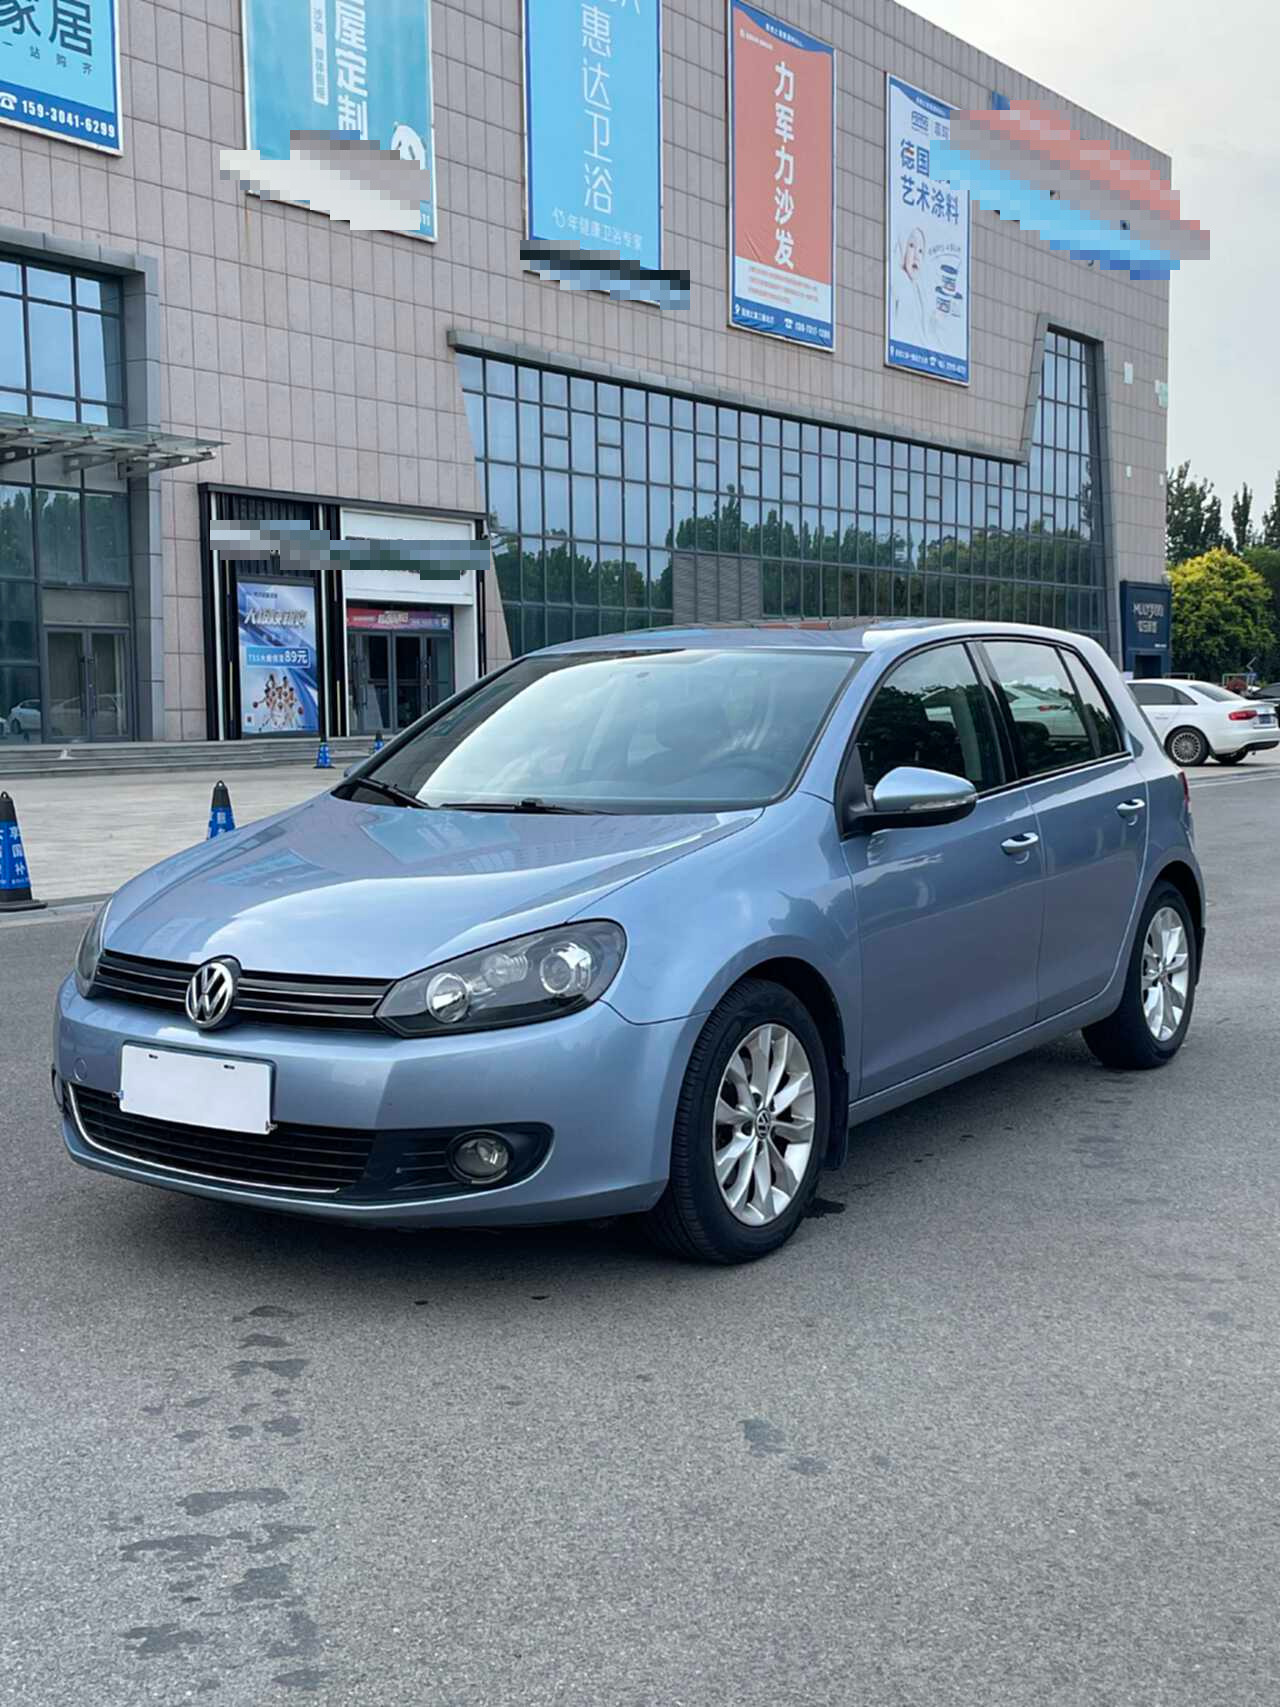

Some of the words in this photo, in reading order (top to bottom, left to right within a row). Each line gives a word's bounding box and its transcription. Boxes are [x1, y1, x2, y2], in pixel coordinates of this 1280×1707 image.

[0, 0, 92, 56] 家居
[580, 3, 613, 214] 惠达卫浴
[774, 61, 795, 269] 力军力沙发
[900, 174, 959, 225] 艺术涂料
[186, 963, 233, 1028] VW
